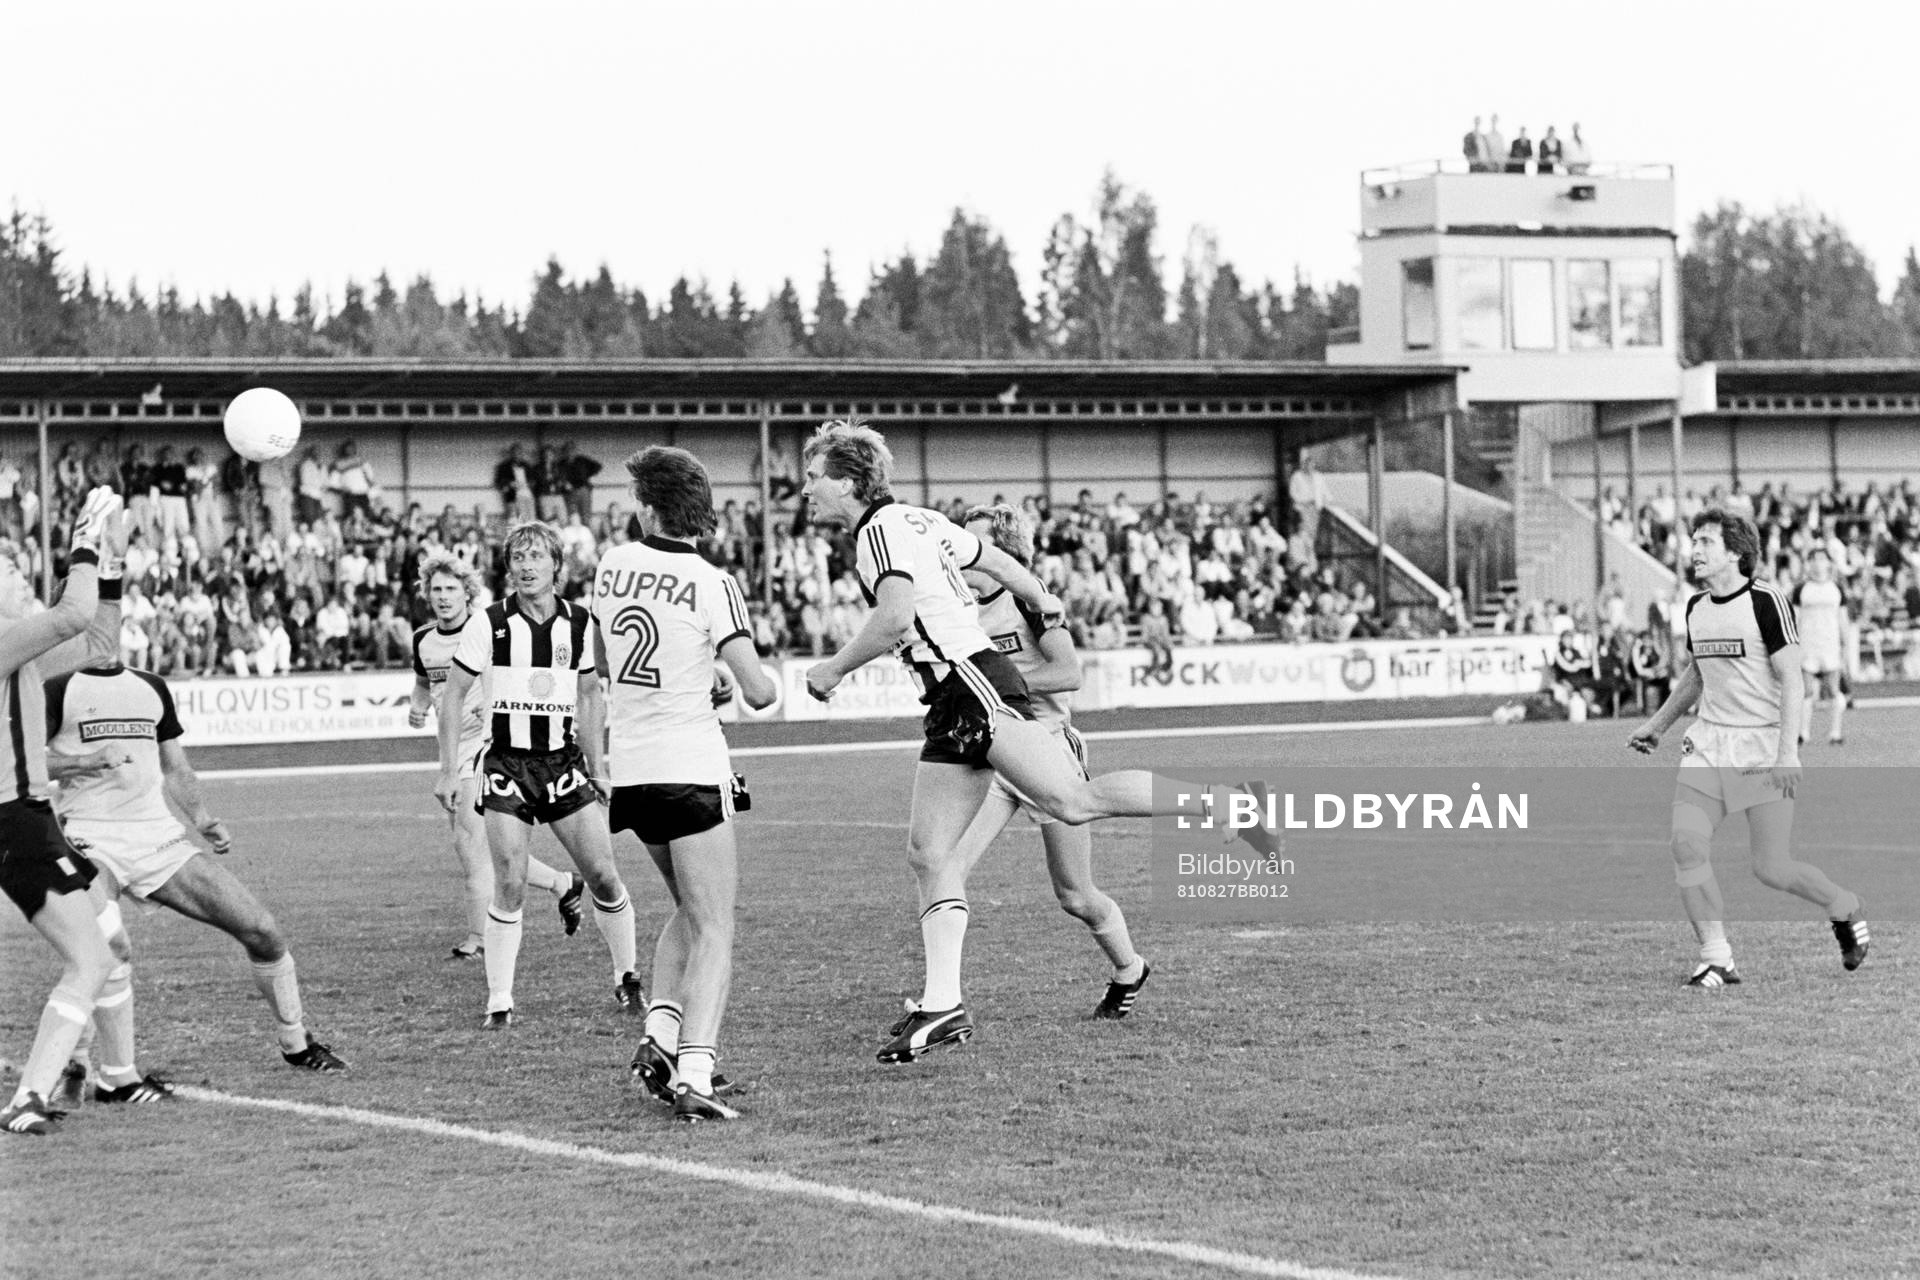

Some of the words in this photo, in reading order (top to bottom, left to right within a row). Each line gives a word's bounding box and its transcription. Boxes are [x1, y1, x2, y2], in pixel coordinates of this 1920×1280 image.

[598, 569, 697, 613] SUPRA
[610, 604, 661, 689] 2
[84, 723, 153, 737] MODULENT
[546, 767, 588, 804] ICA
